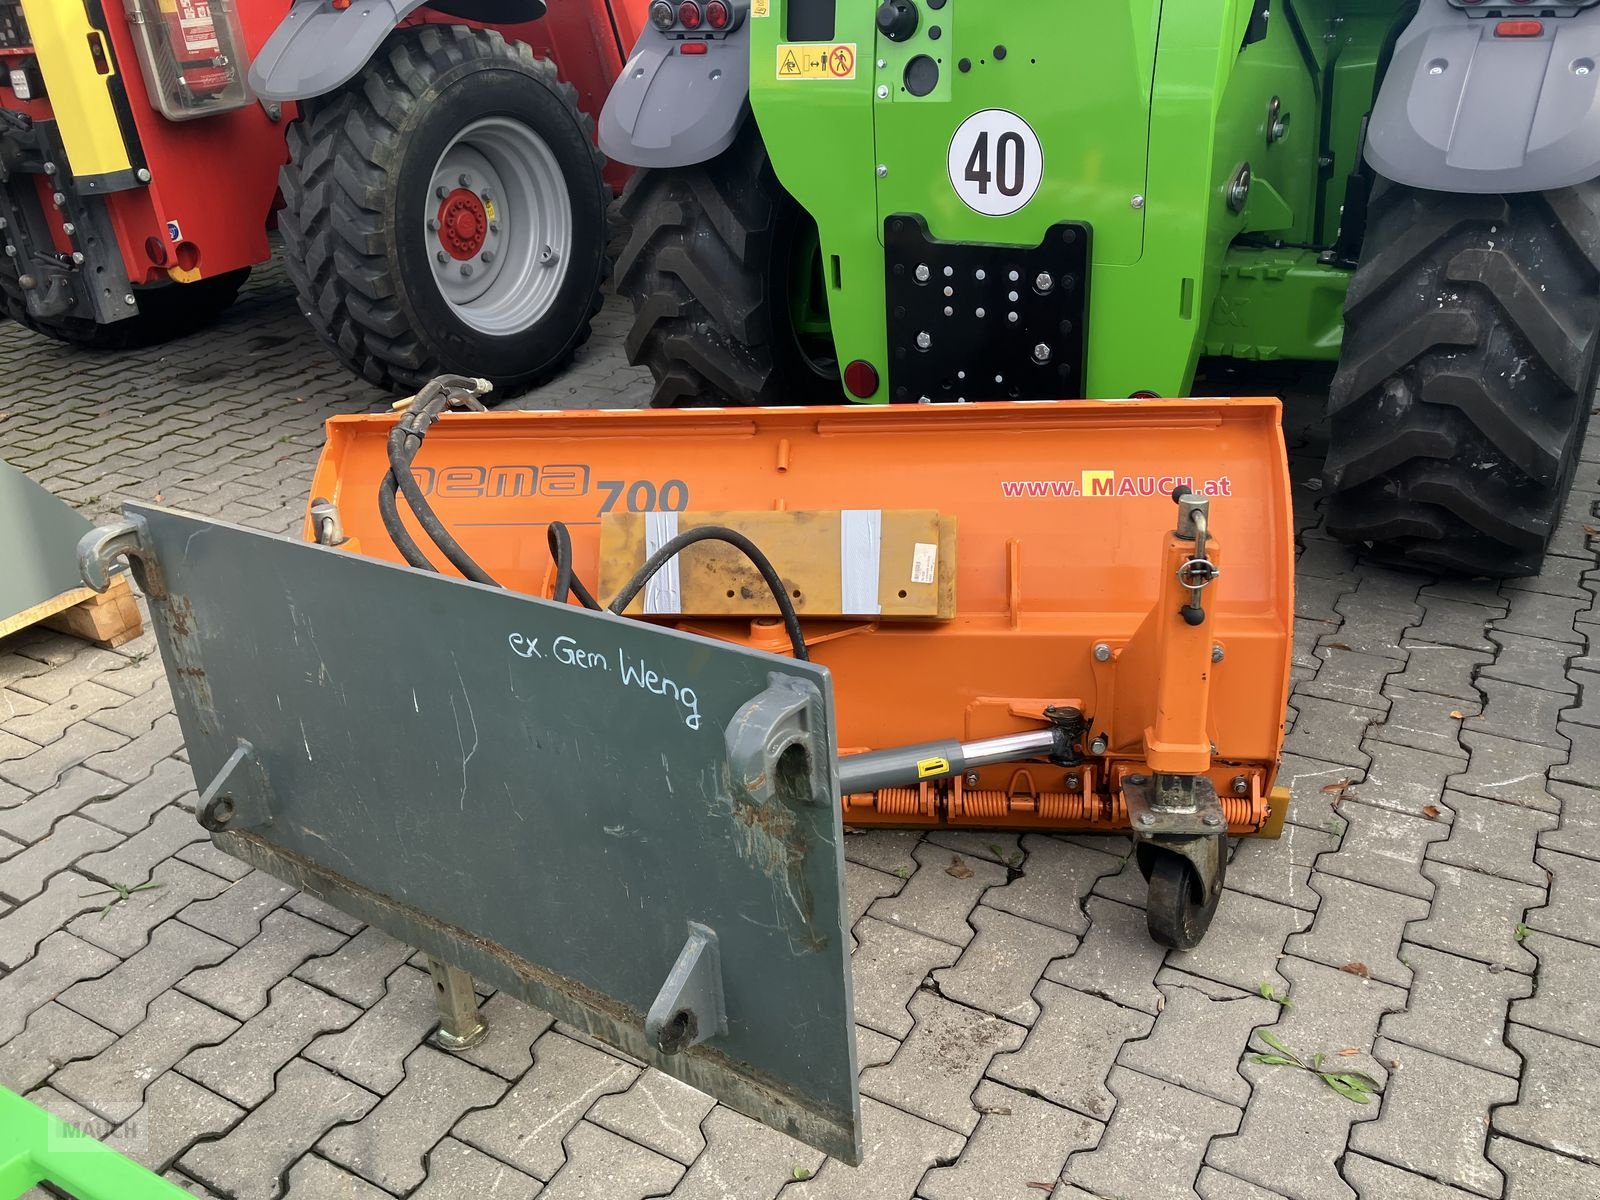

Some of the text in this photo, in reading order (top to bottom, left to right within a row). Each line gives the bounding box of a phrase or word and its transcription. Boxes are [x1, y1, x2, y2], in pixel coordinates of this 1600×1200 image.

[964, 131, 1025, 197] 40
[595, 479, 689, 517] 700
[508, 632, 702, 731] ex. Gem. Weng
